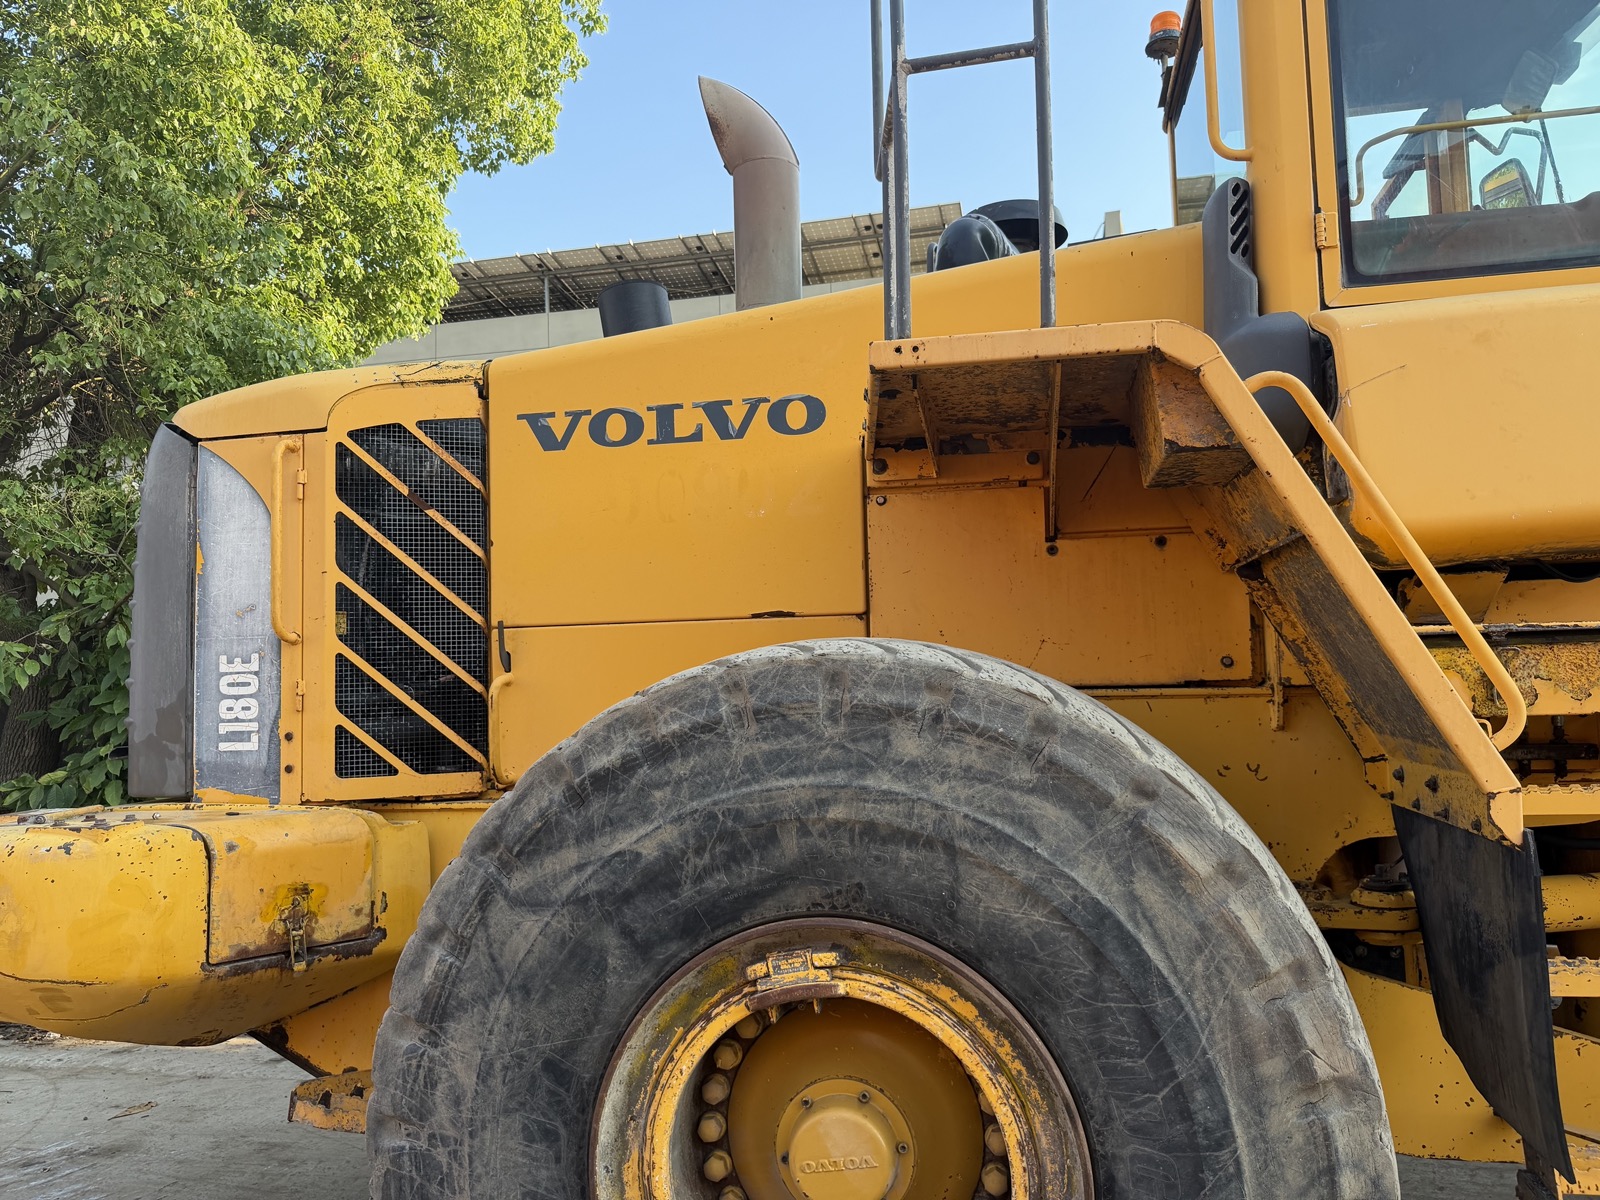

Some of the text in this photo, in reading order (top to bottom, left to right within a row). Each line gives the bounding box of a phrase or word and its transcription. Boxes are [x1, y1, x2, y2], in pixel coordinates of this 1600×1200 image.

[516, 393, 827, 452] VOLVO
[218, 653, 259, 751] L180E
[801, 1155, 879, 1174] VOLVO
